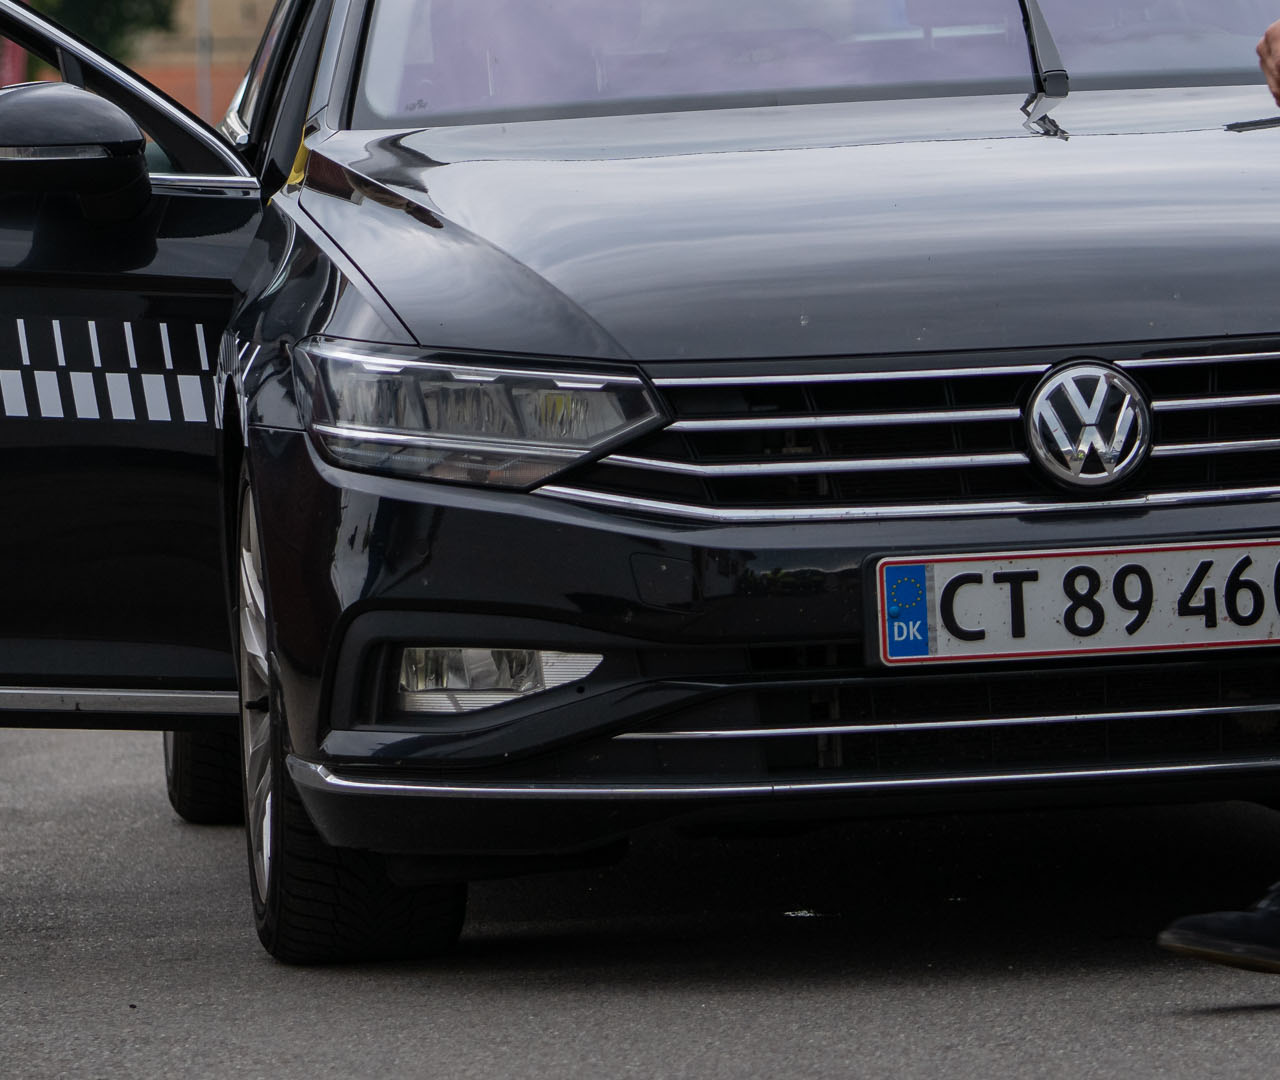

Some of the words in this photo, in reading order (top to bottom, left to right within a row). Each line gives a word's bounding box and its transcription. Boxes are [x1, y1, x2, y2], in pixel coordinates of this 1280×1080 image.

[1032, 366, 1141, 482] VW
[893, 620, 924, 642] DK
[939, 569, 1040, 642] CT
[1062, 563, 1154, 638] 89
